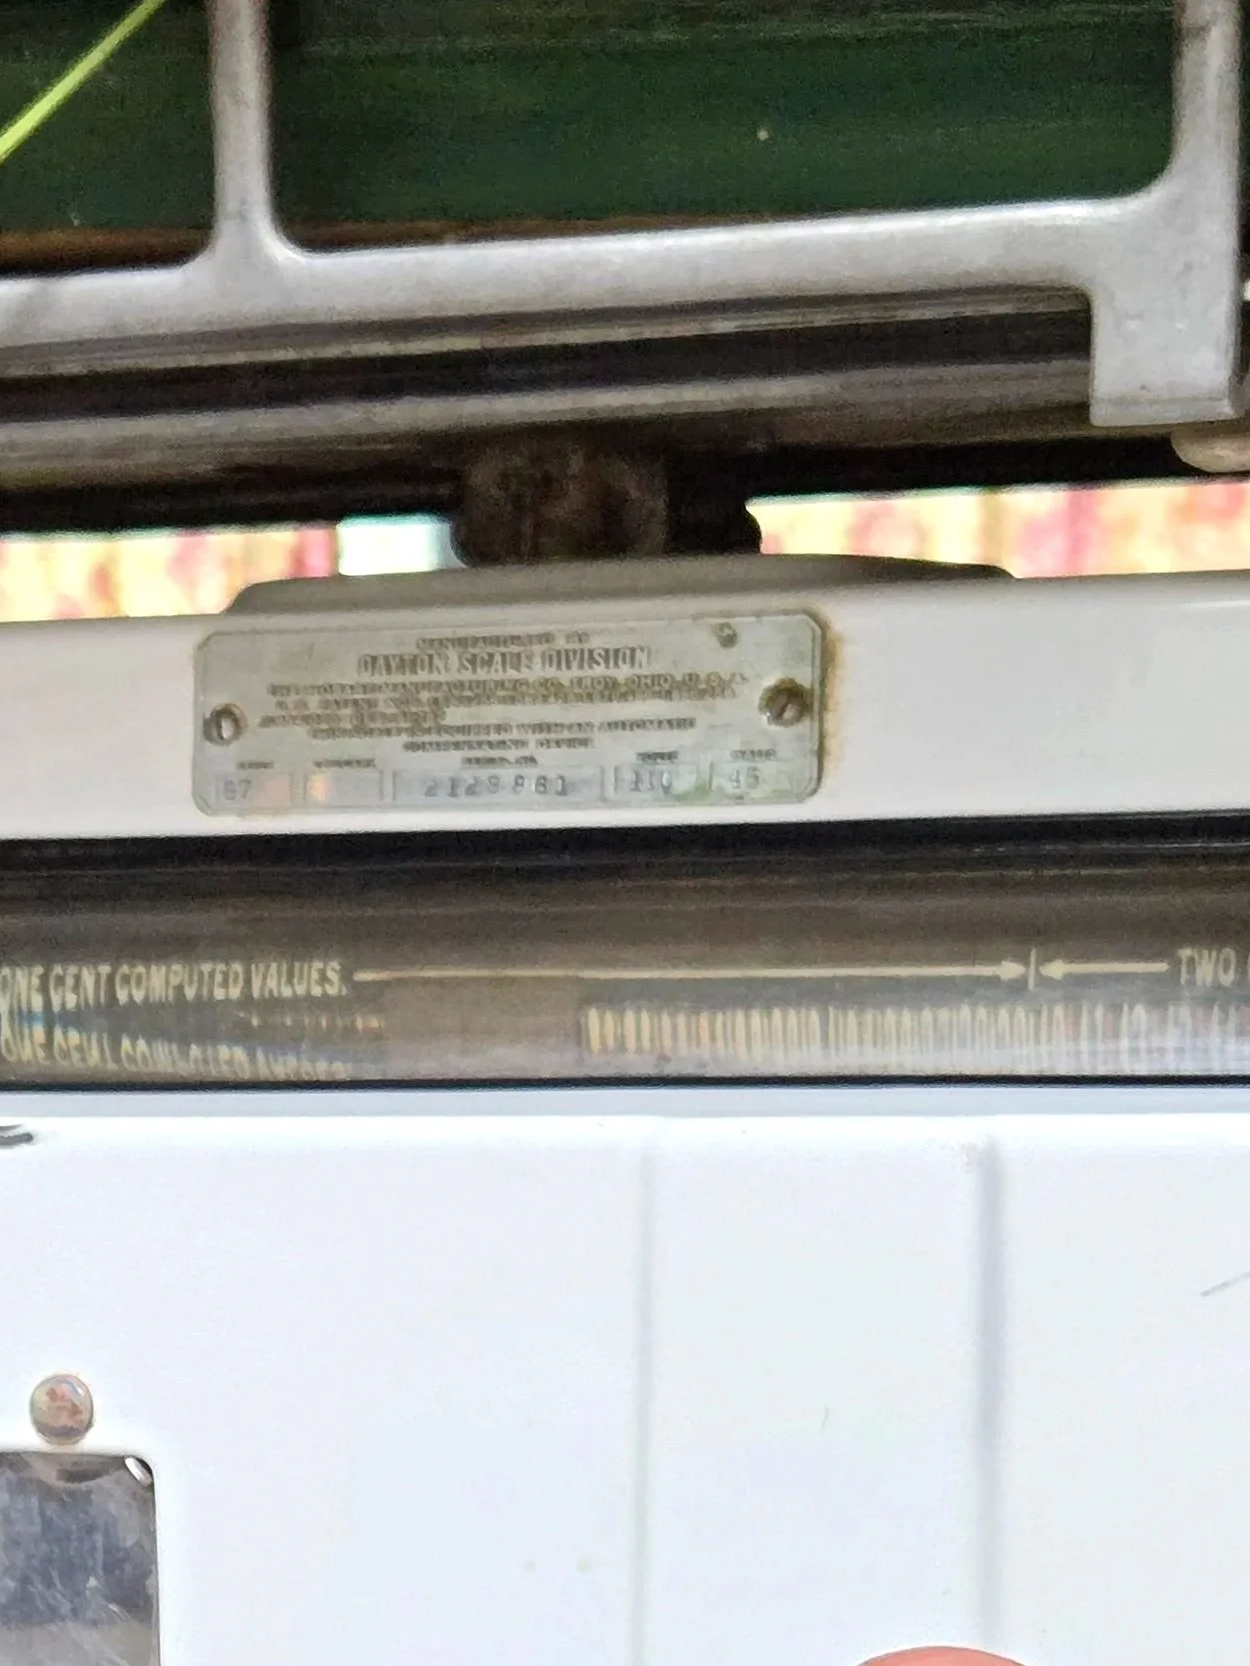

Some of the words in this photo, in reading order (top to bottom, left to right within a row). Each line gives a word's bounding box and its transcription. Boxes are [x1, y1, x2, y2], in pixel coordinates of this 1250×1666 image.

[357, 653, 450, 677] DAYTON
[456, 649, 535, 675] SCALE
[539, 645, 651, 672] DIVISION
[49, 964, 112, 1012] CENT
[114, 961, 245, 1006] COMPUTED
[250, 960, 347, 998] VALUES.
[1177, 946, 1236, 988] TWO
